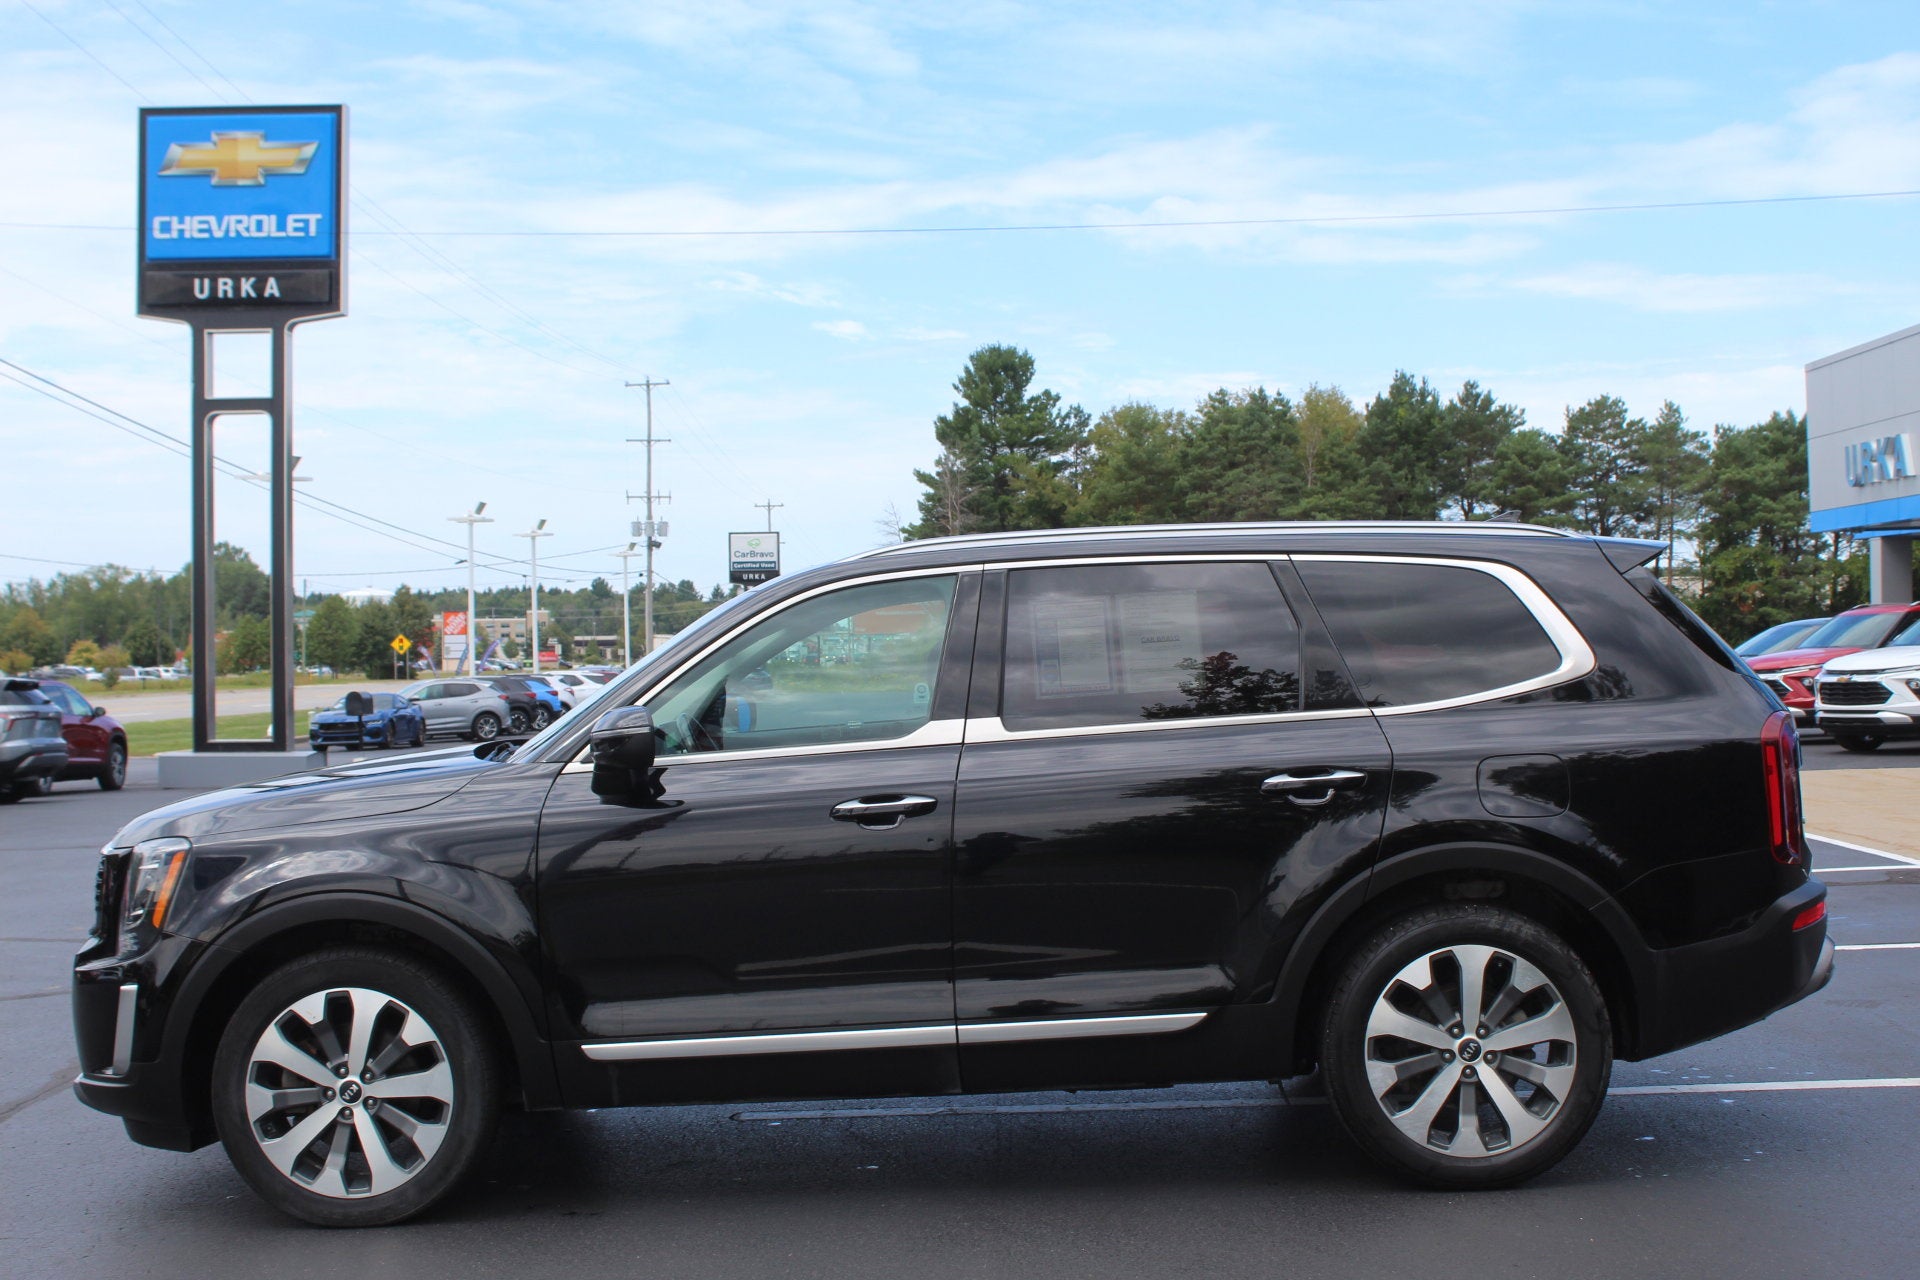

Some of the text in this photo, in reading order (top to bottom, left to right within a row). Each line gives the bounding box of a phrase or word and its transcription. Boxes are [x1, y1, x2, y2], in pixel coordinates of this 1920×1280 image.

[152, 213, 323, 239] CHEVROLET
[193, 276, 281, 299] URKA
[1845, 432, 1914, 487] URKA
[733, 550, 775, 558] CarBravo
[1462, 1042, 1478, 1060] KIA
[341, 1083, 360, 1100] KIA
